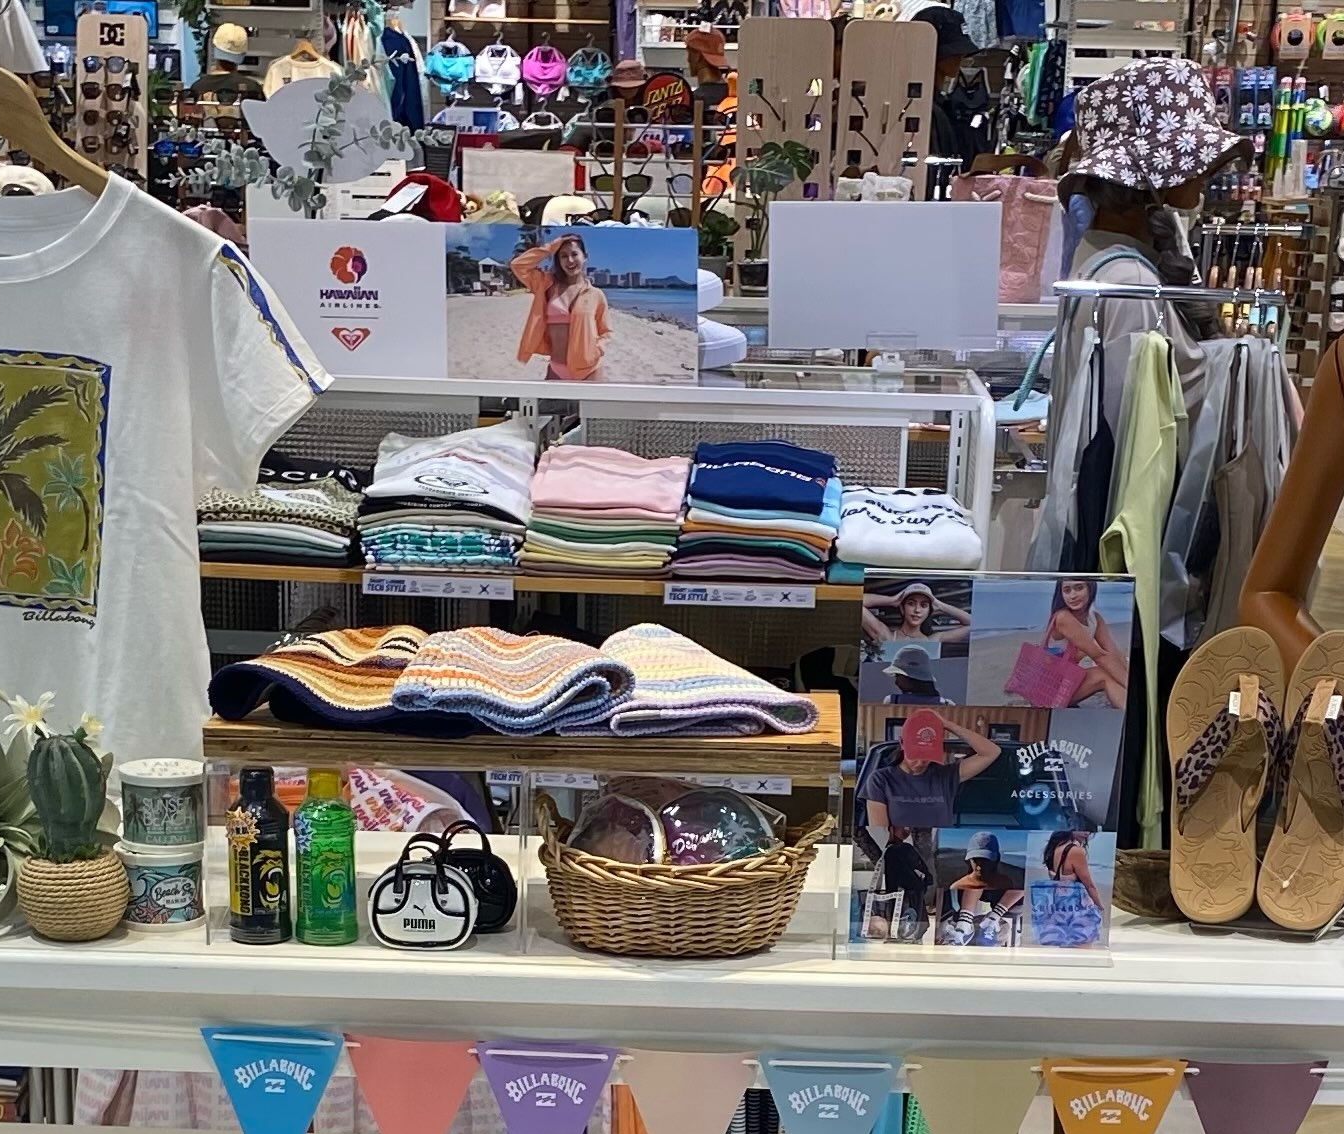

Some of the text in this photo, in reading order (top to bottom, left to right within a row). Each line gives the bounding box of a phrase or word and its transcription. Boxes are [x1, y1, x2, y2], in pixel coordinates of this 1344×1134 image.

[319, 285, 379, 301] HAWAIIAN
[22, 609, 96, 630] Billabong
[1016, 739, 1093, 769] BILLABONG
[1010, 790, 1093, 801] ACCESSORIES
[403, 917, 437, 932] PUMA
[233, 1058, 316, 1092] BILLABONG
[505, 1072, 588, 1106] BILLABONG
[787, 1083, 871, 1118] BILLABONG
[1069, 1089, 1154, 1122] BILLABONG
